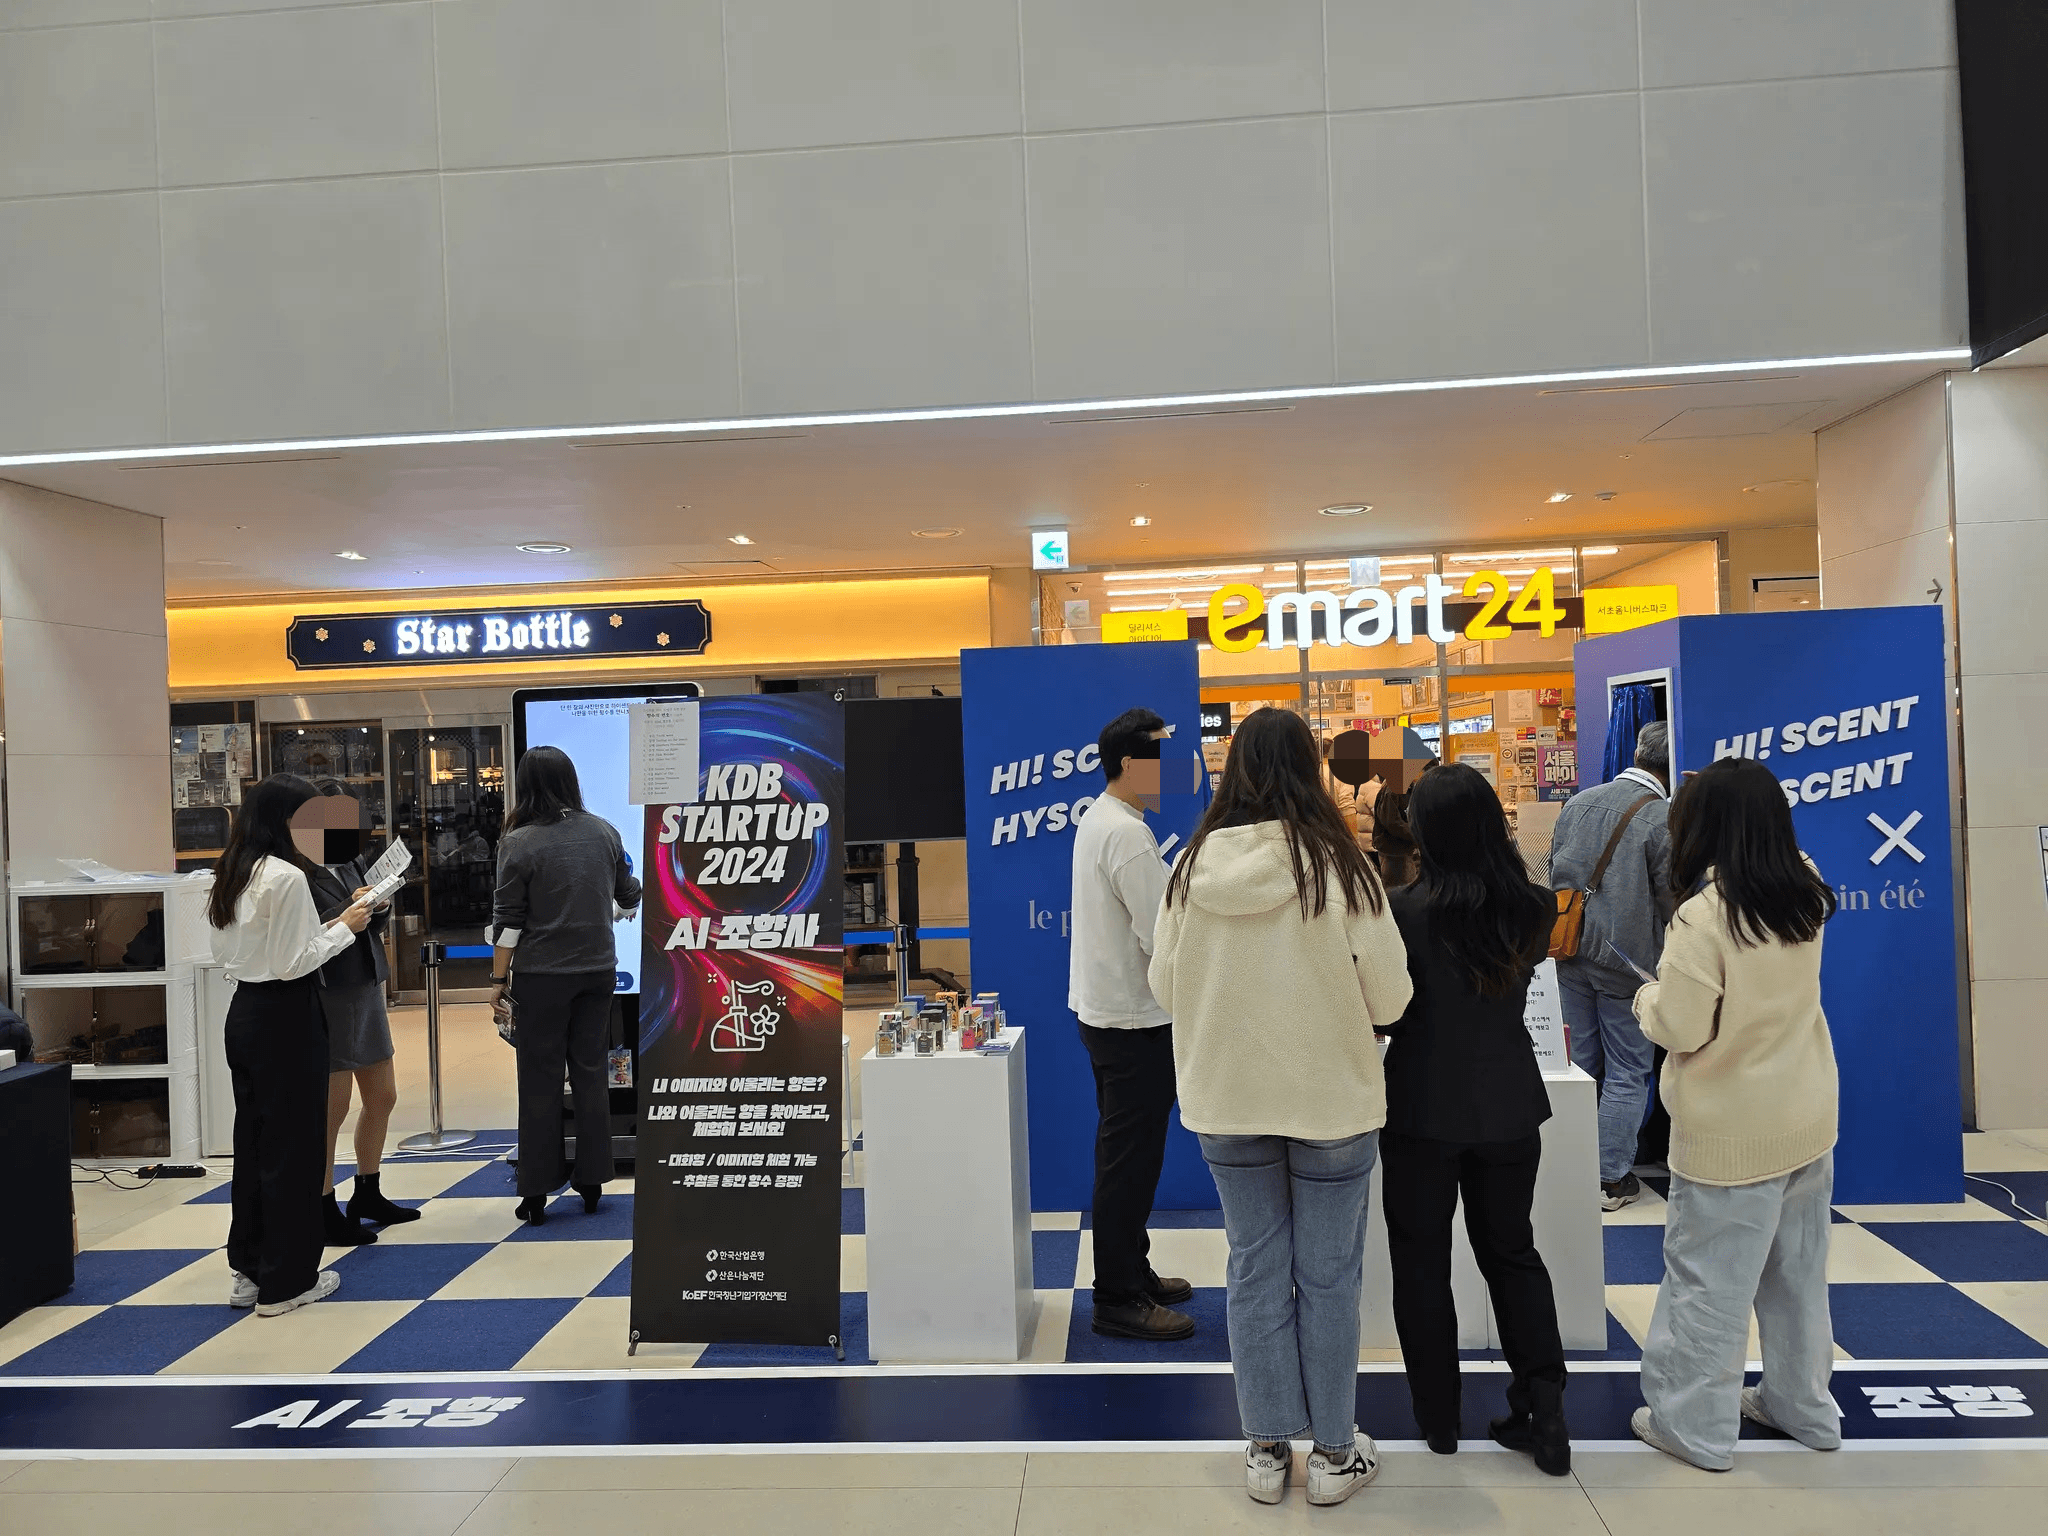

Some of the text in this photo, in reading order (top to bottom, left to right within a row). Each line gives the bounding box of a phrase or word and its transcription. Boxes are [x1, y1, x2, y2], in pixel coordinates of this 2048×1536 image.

[1208, 566, 1566, 653] emart24
[1598, 604, 1667, 615] 서초옴니버스파크
[397, 611, 590, 654] Star Bottle
[1713, 695, 1919, 763] HI! SCENT
[1544, 750, 1575, 766] 서울
[705, 763, 784, 801] KDB
[990, 753, 1045, 794] HI!
[1544, 766, 1576, 782] 페이
[658, 802, 829, 843] STARTUP
[697, 846, 789, 885] 2024
[1880, 879, 1925, 910] été
[1029, 900, 1052, 929] le
[664, 913, 820, 950] AI 조향사
[652, 1076, 827, 1093] 내 이미지와 어울리는 향은?
[648, 1104, 830, 1122] 나와 어울리는 향을 찾아보고,
[692, 1121, 786, 1137] 체험해 보세요!
[668, 1153, 706, 1167] 대화형
[716, 1153, 764, 1167] 이미지형
[765, 1153, 791, 1167] 체험
[793, 1153, 818, 1167] 가능
[683, 1174, 719, 1188] 추첨을
[721, 1174, 747, 1188] 통한
[748, 1174, 772, 1188] 향수
[774, 1175, 803, 1188] 증정!
[720, 1251, 765, 1261] 한국산업은행
[719, 1271, 765, 1281] 산은나눔재단
[682, 1290, 787, 1301] KoEF 한국청년기업가정신재단
[231, 1396, 526, 1428] AI 조향
[1860, 1385, 2034, 1418] 조향
